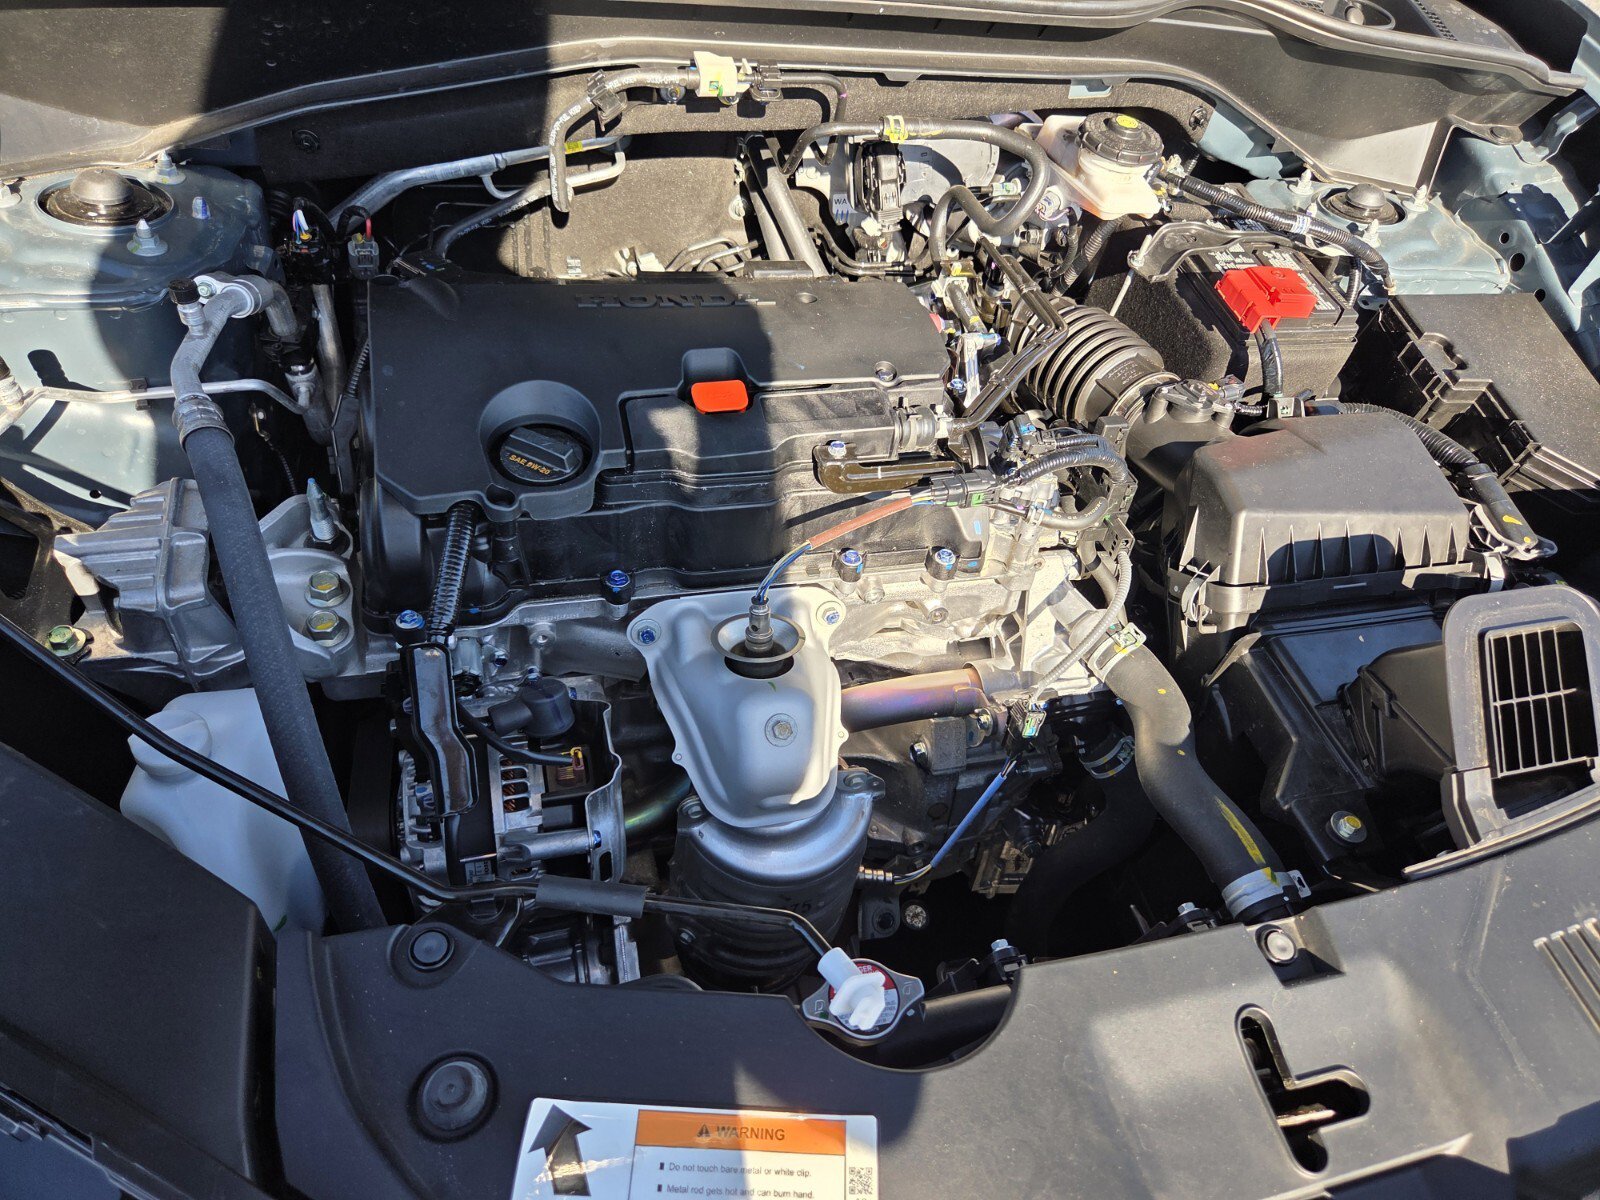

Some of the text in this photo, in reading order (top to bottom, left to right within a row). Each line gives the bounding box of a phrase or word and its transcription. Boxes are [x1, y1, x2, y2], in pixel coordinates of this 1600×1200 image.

[509, 454, 527, 466] SAE
[716, 1126, 785, 1141] WARNING
[669, 1162, 680, 1171] Do
[682, 1163, 695, 1172] not
[697, 1163, 718, 1173] touch
[720, 1164, 738, 1174] bare
[740, 1165, 762, 1175] metal
[774, 1167, 794, 1176] white
[796, 1168, 812, 1179] clip.
[666, 1184, 815, 1199] Metal rod gets hot and can burn hand.
